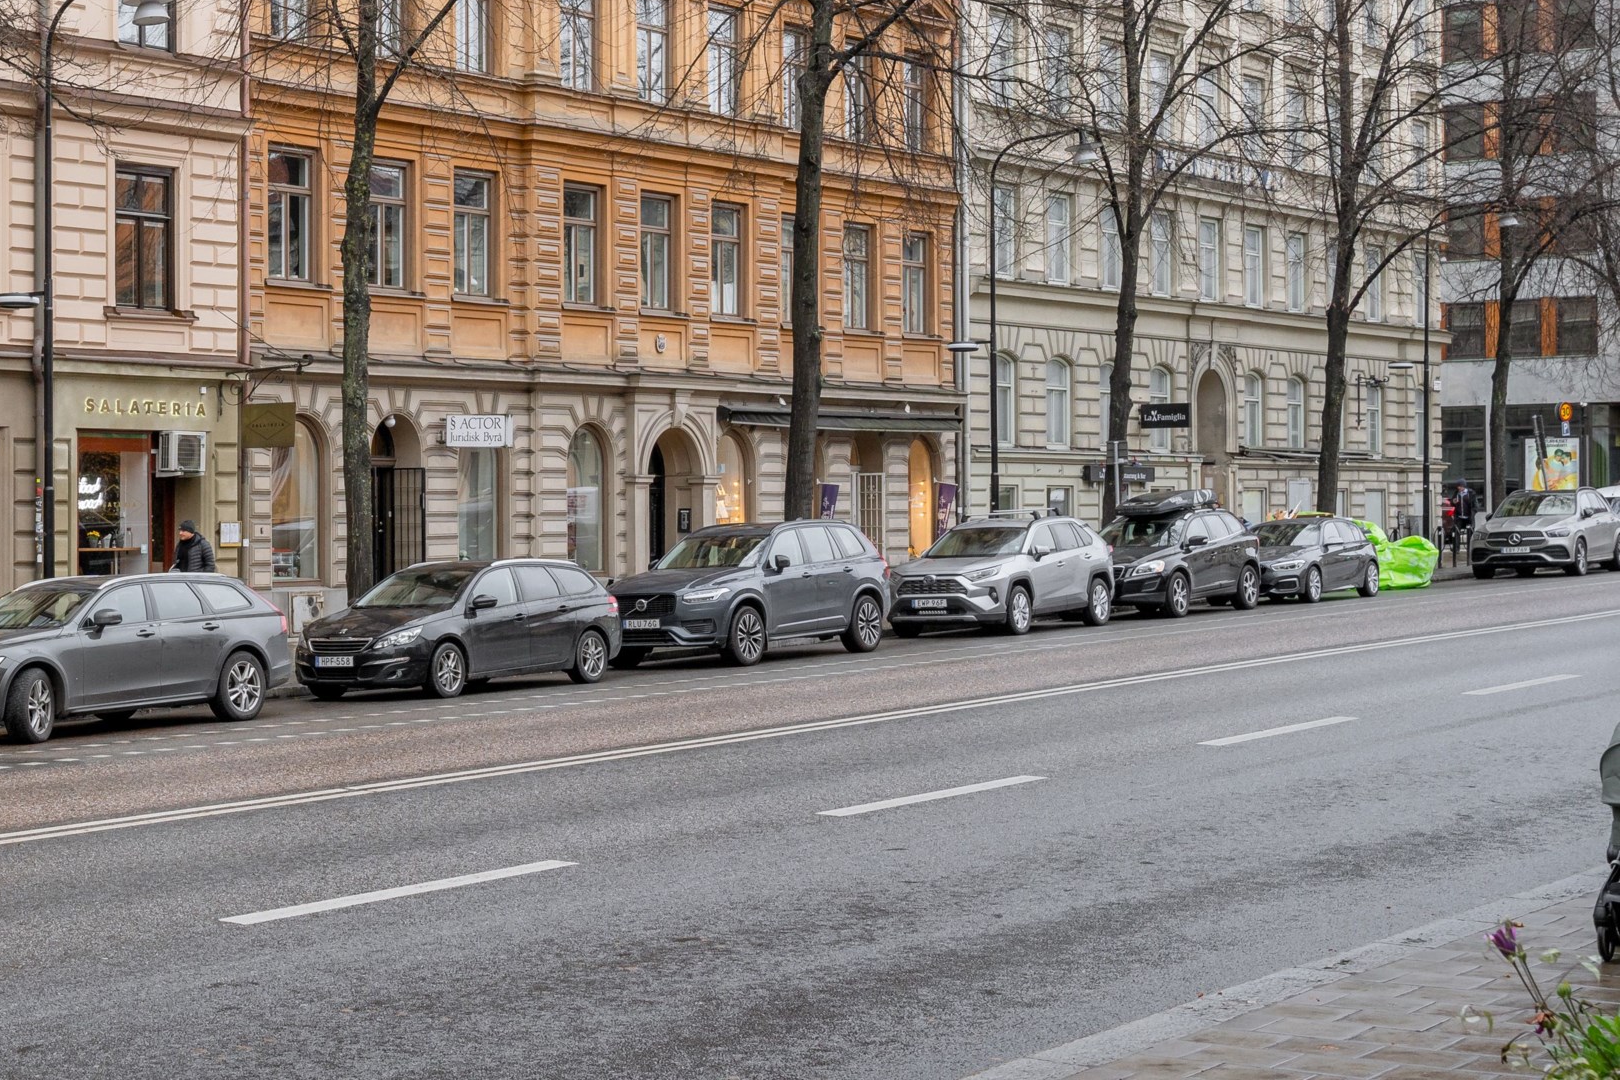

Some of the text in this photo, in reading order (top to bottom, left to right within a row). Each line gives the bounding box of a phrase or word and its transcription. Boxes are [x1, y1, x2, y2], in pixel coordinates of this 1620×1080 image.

[84, 396, 207, 418] SALATERIA
[1561, 406, 1570, 417] 30
[1157, 412, 1186, 422] Famiglia
[460, 416, 502, 430] ACTOR
[450, 431, 502, 445] Juridisk Byrå
[628, 620, 657, 628] RLU 76G
[321, 657, 351, 666] HPF 558
